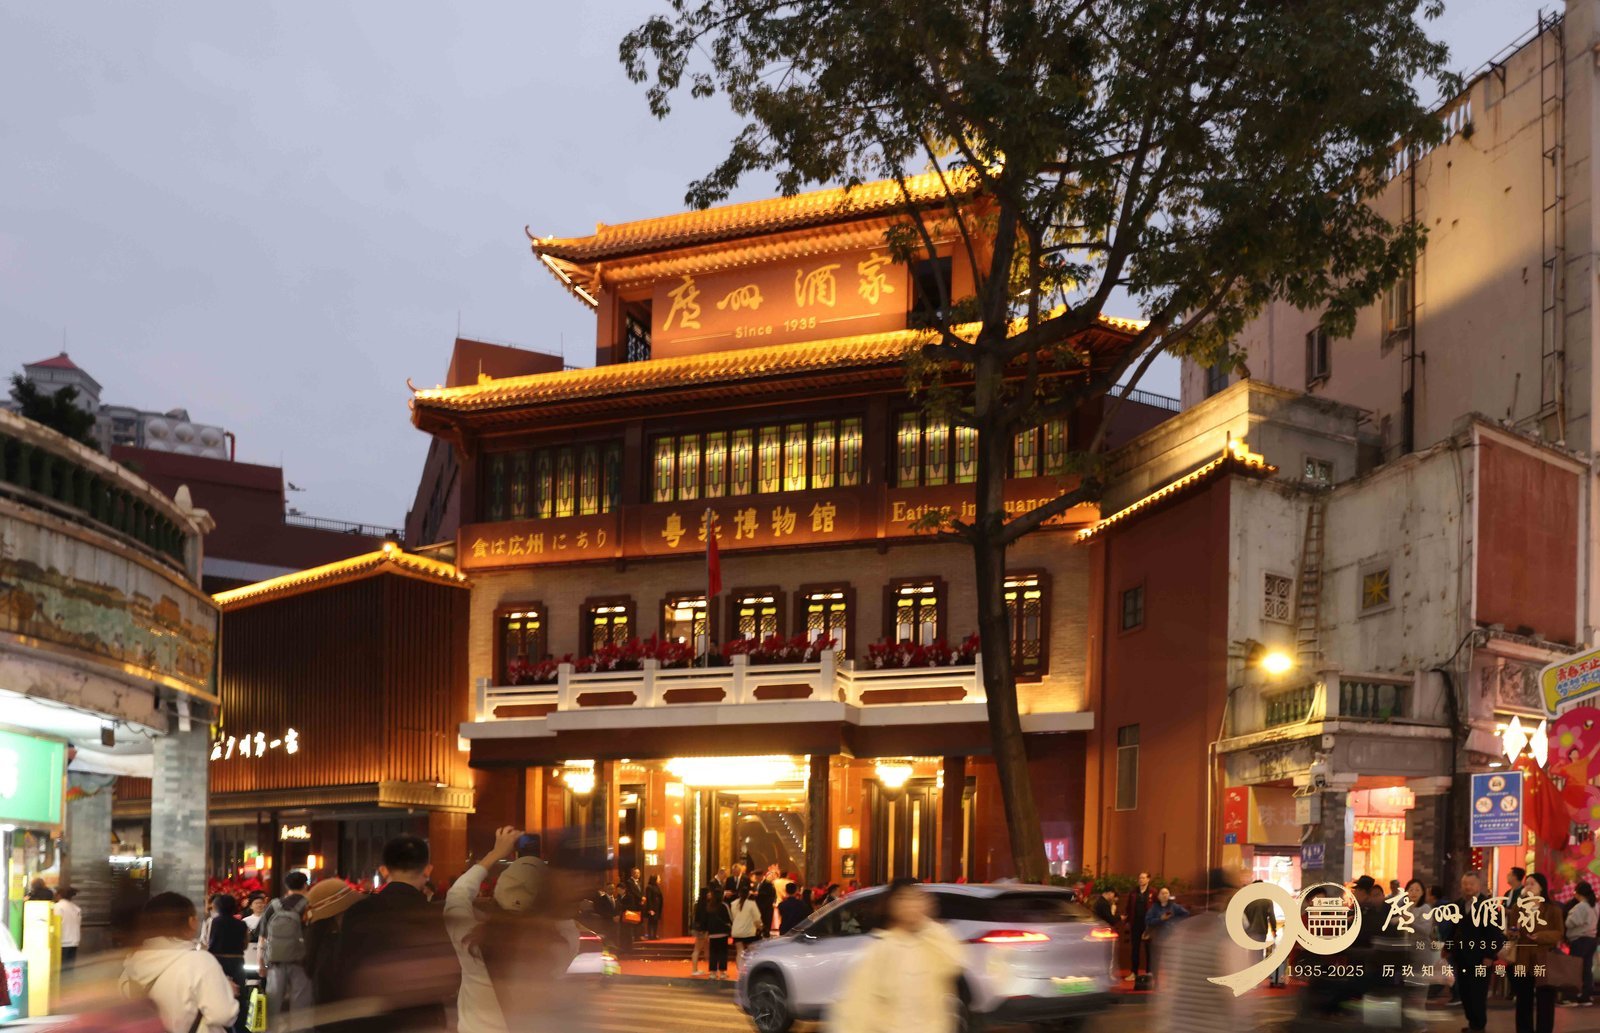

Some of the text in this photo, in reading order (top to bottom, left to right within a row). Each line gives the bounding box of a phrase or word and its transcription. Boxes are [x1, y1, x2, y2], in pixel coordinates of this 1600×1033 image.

[735, 316, 817, 339] Since 1935
[891, 501, 953, 525] Eatig
